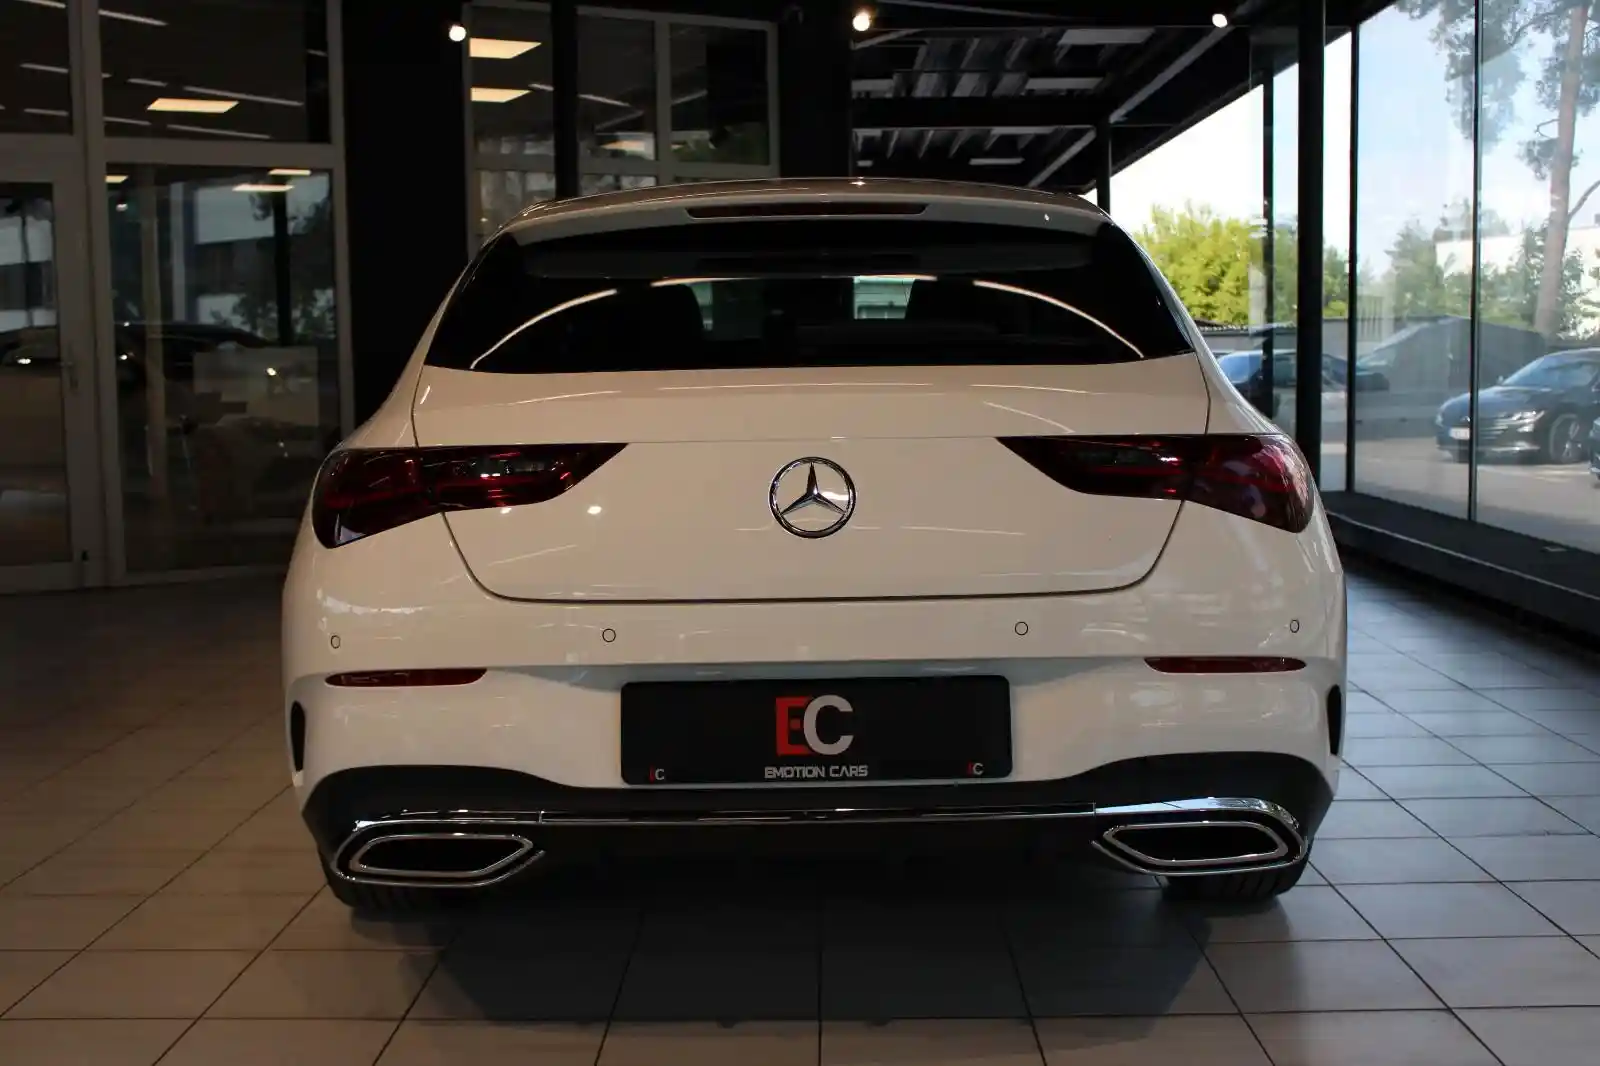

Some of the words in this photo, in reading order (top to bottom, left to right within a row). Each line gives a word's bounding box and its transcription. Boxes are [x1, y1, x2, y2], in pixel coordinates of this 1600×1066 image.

[775, 694, 854, 756] EC
[764, 765, 826, 779] EMOTION
[829, 765, 868, 778] CARS
